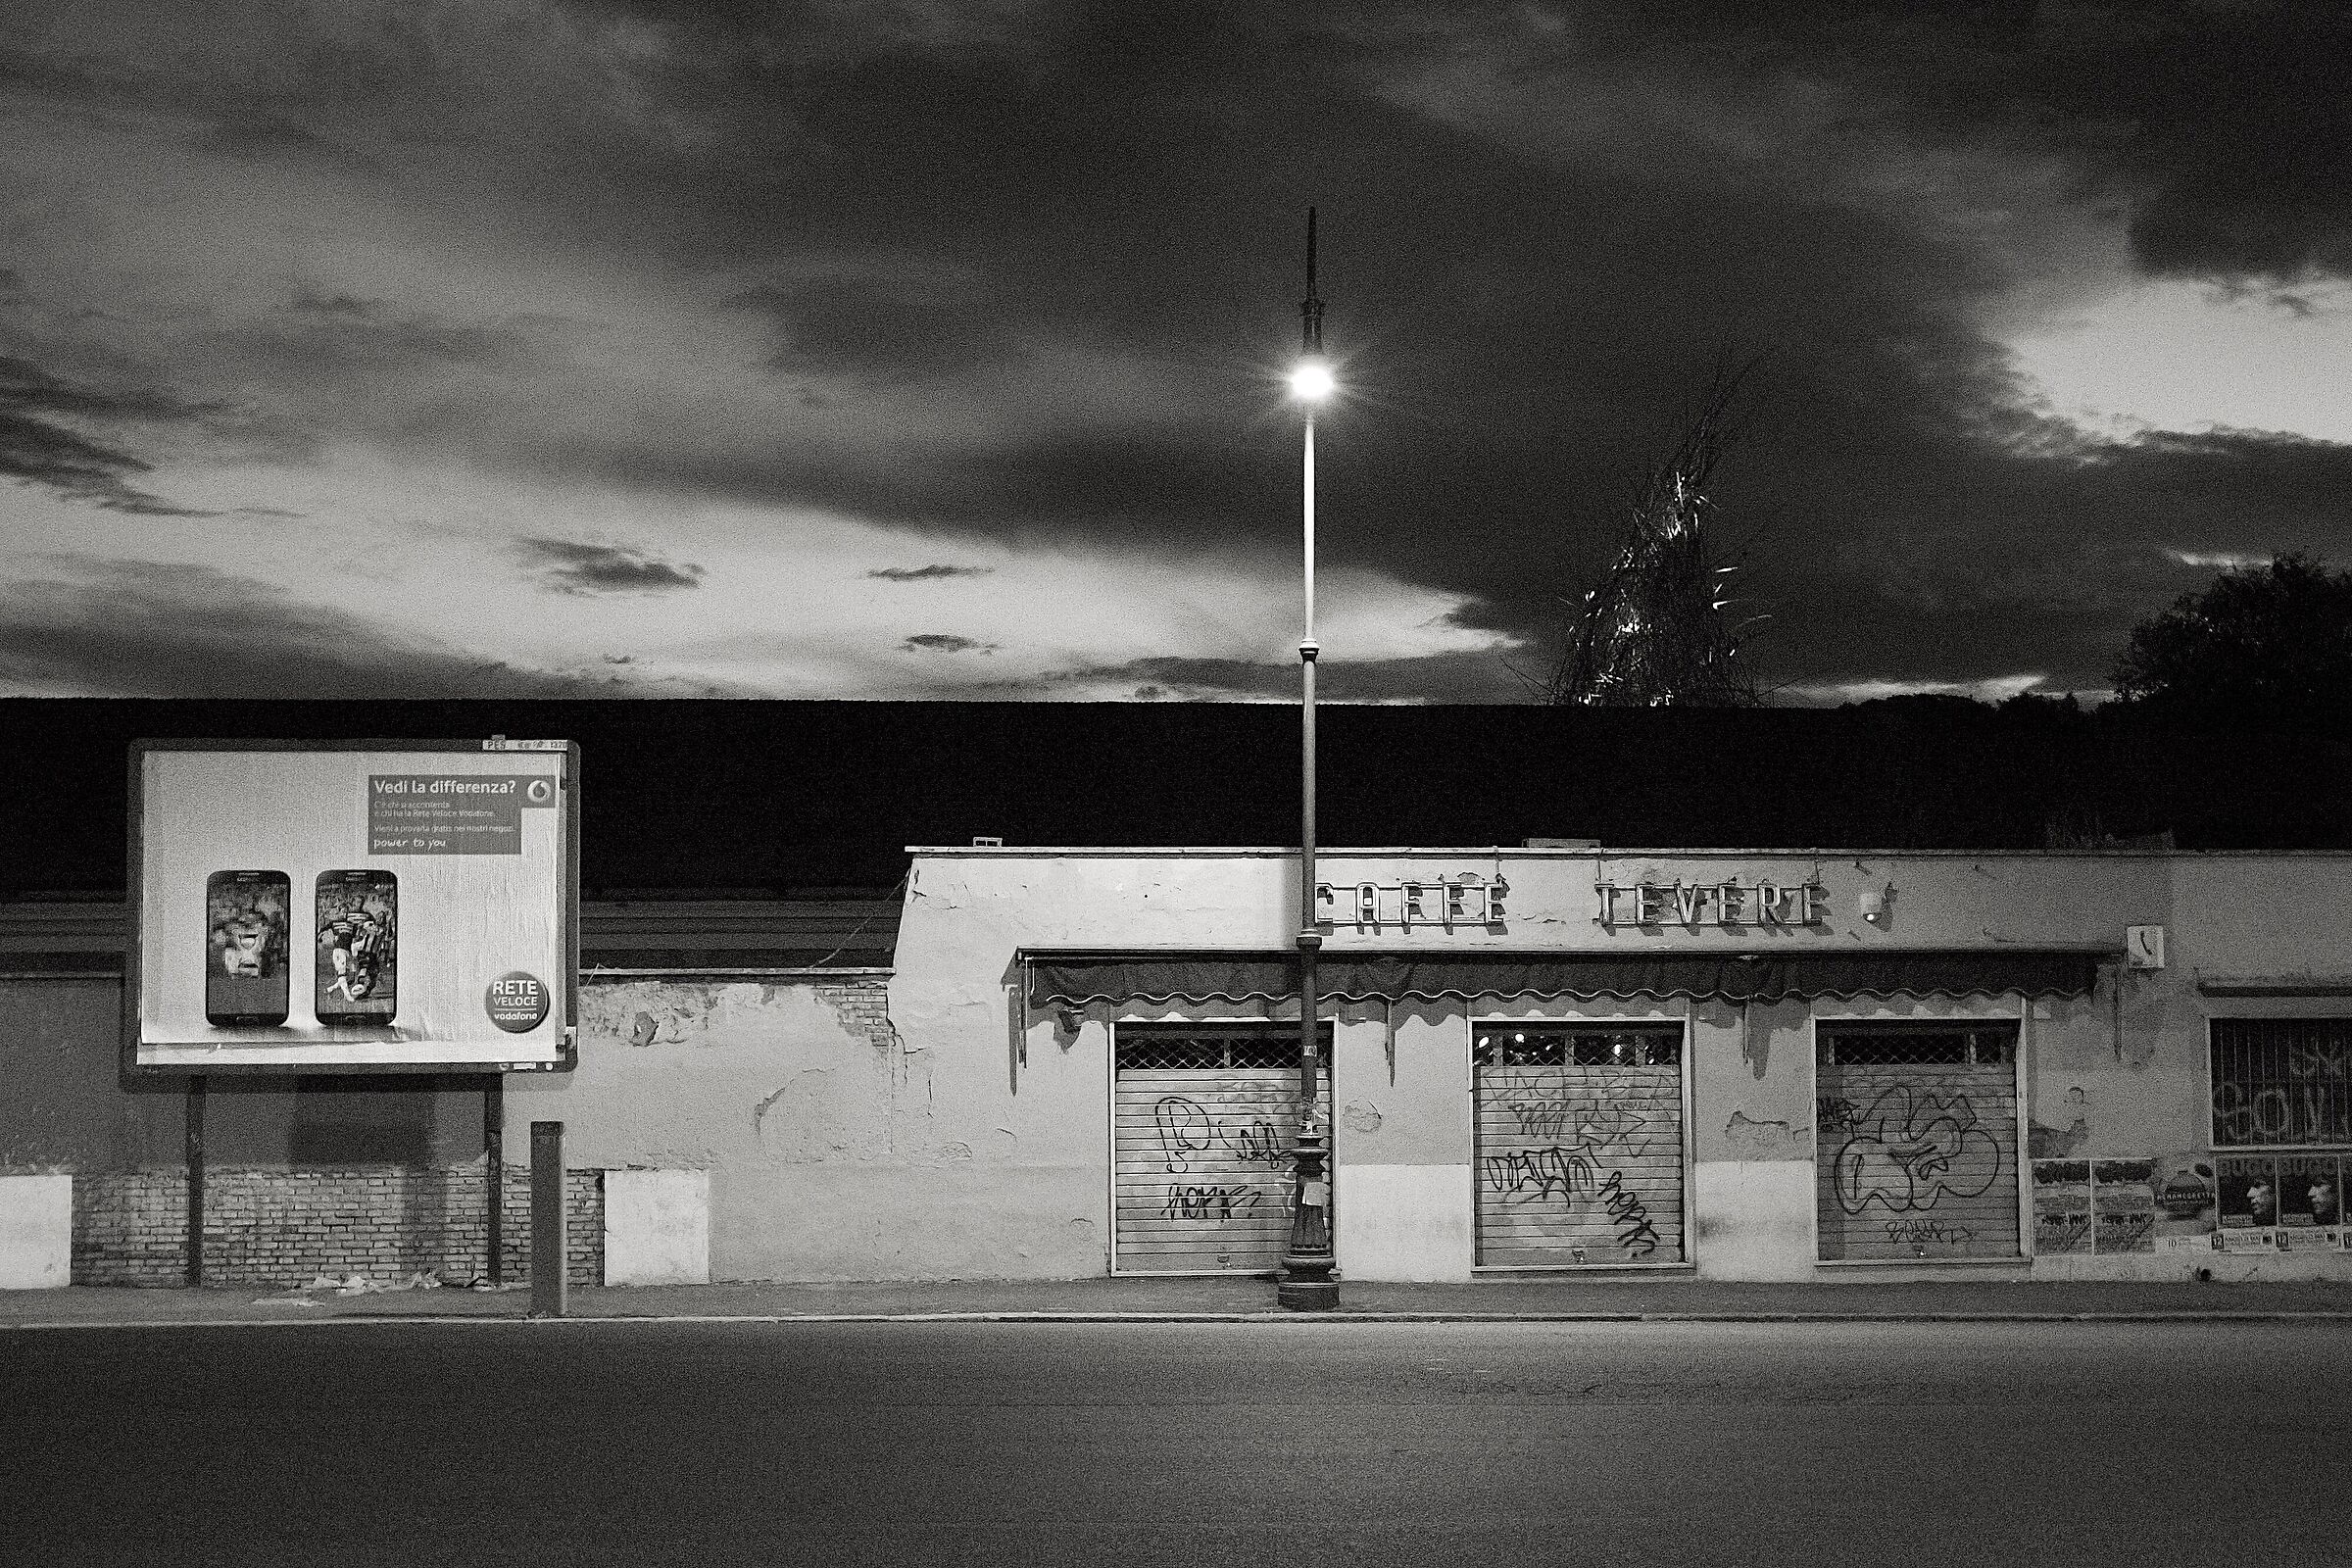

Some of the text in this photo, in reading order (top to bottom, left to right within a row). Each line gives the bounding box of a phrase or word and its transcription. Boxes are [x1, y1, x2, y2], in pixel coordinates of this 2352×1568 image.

[374, 780, 516, 794] Vedi la differenza?
[373, 838, 446, 852] power to you
[1594, 882, 1824, 926] TEVERE
[493, 980, 539, 995] RETE
[493, 996, 538, 1006] VELOCE
[494, 1011, 538, 1020] vodafone
